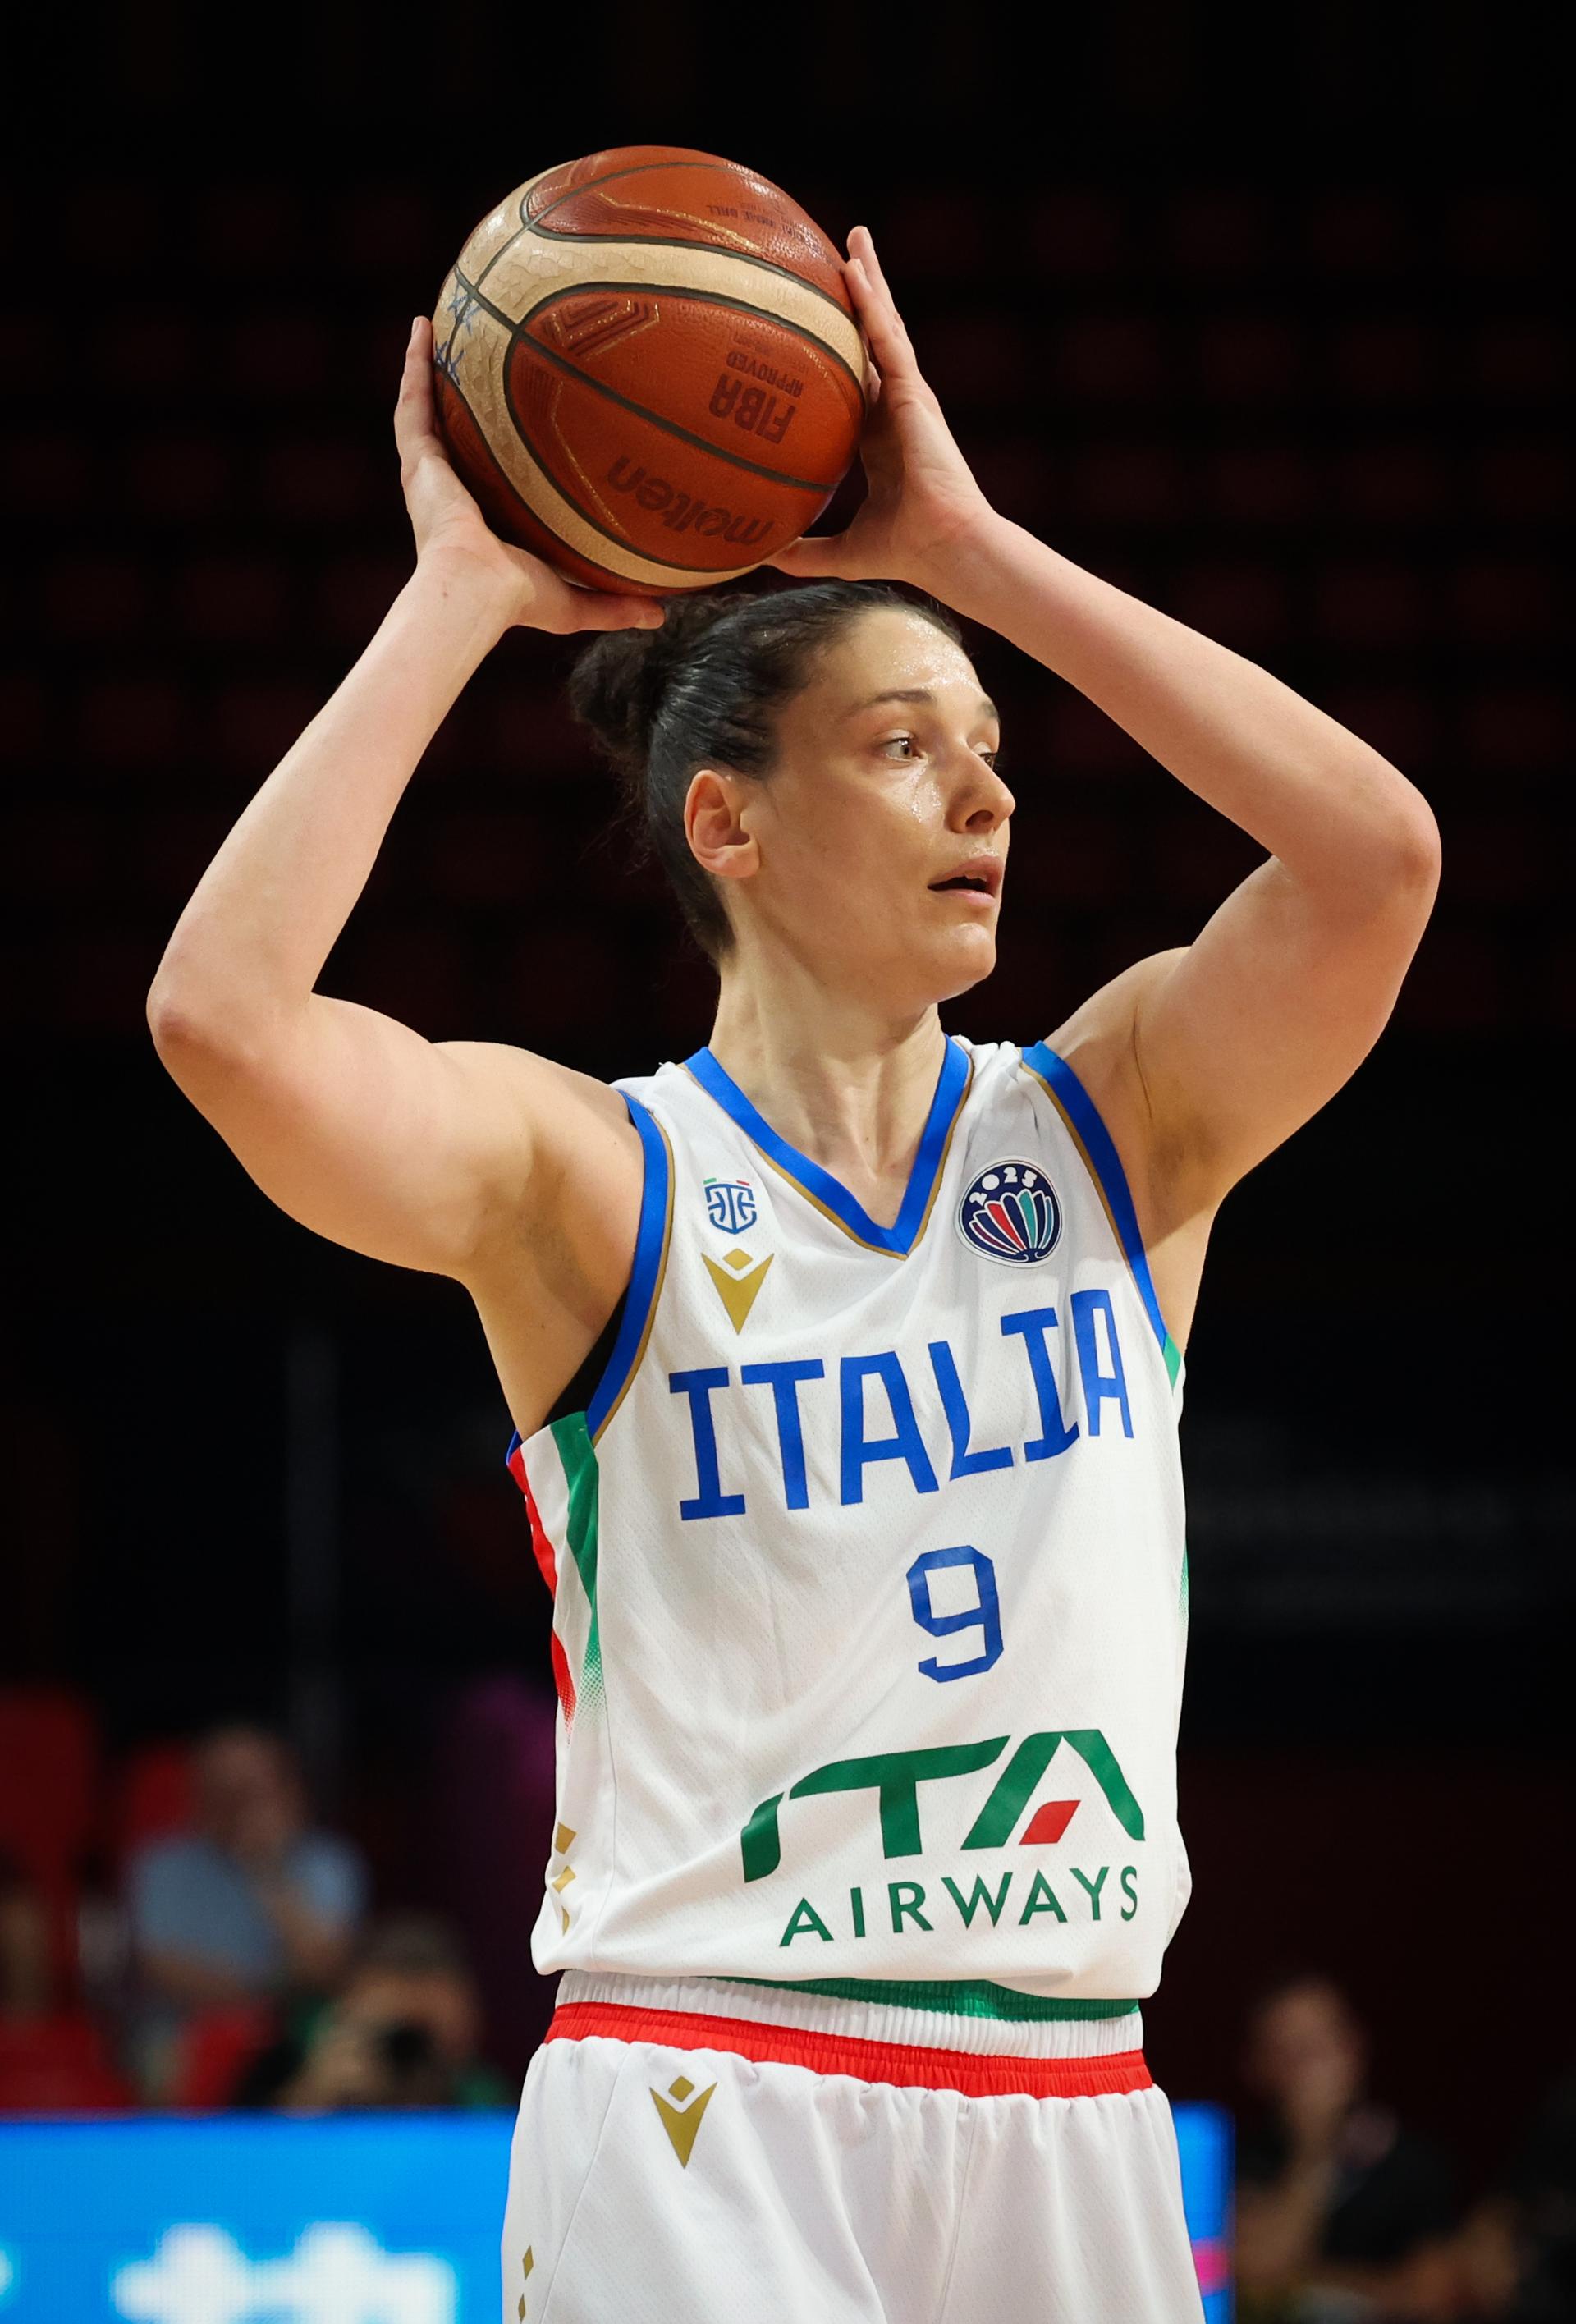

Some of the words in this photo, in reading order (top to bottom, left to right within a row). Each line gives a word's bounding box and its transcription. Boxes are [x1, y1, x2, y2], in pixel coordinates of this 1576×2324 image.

[708, 374, 797, 445] FIBA
[725, 351, 804, 399] APPROVED
[606, 455, 776, 546] molten
[969, 1166, 1038, 1205] 2025
[668, 1289, 1134, 1521] ITALIA
[905, 1545, 1004, 1683] 9
[740, 1729, 1145, 1883] ITA
[779, 1865, 1138, 1947] AIRWAYS
